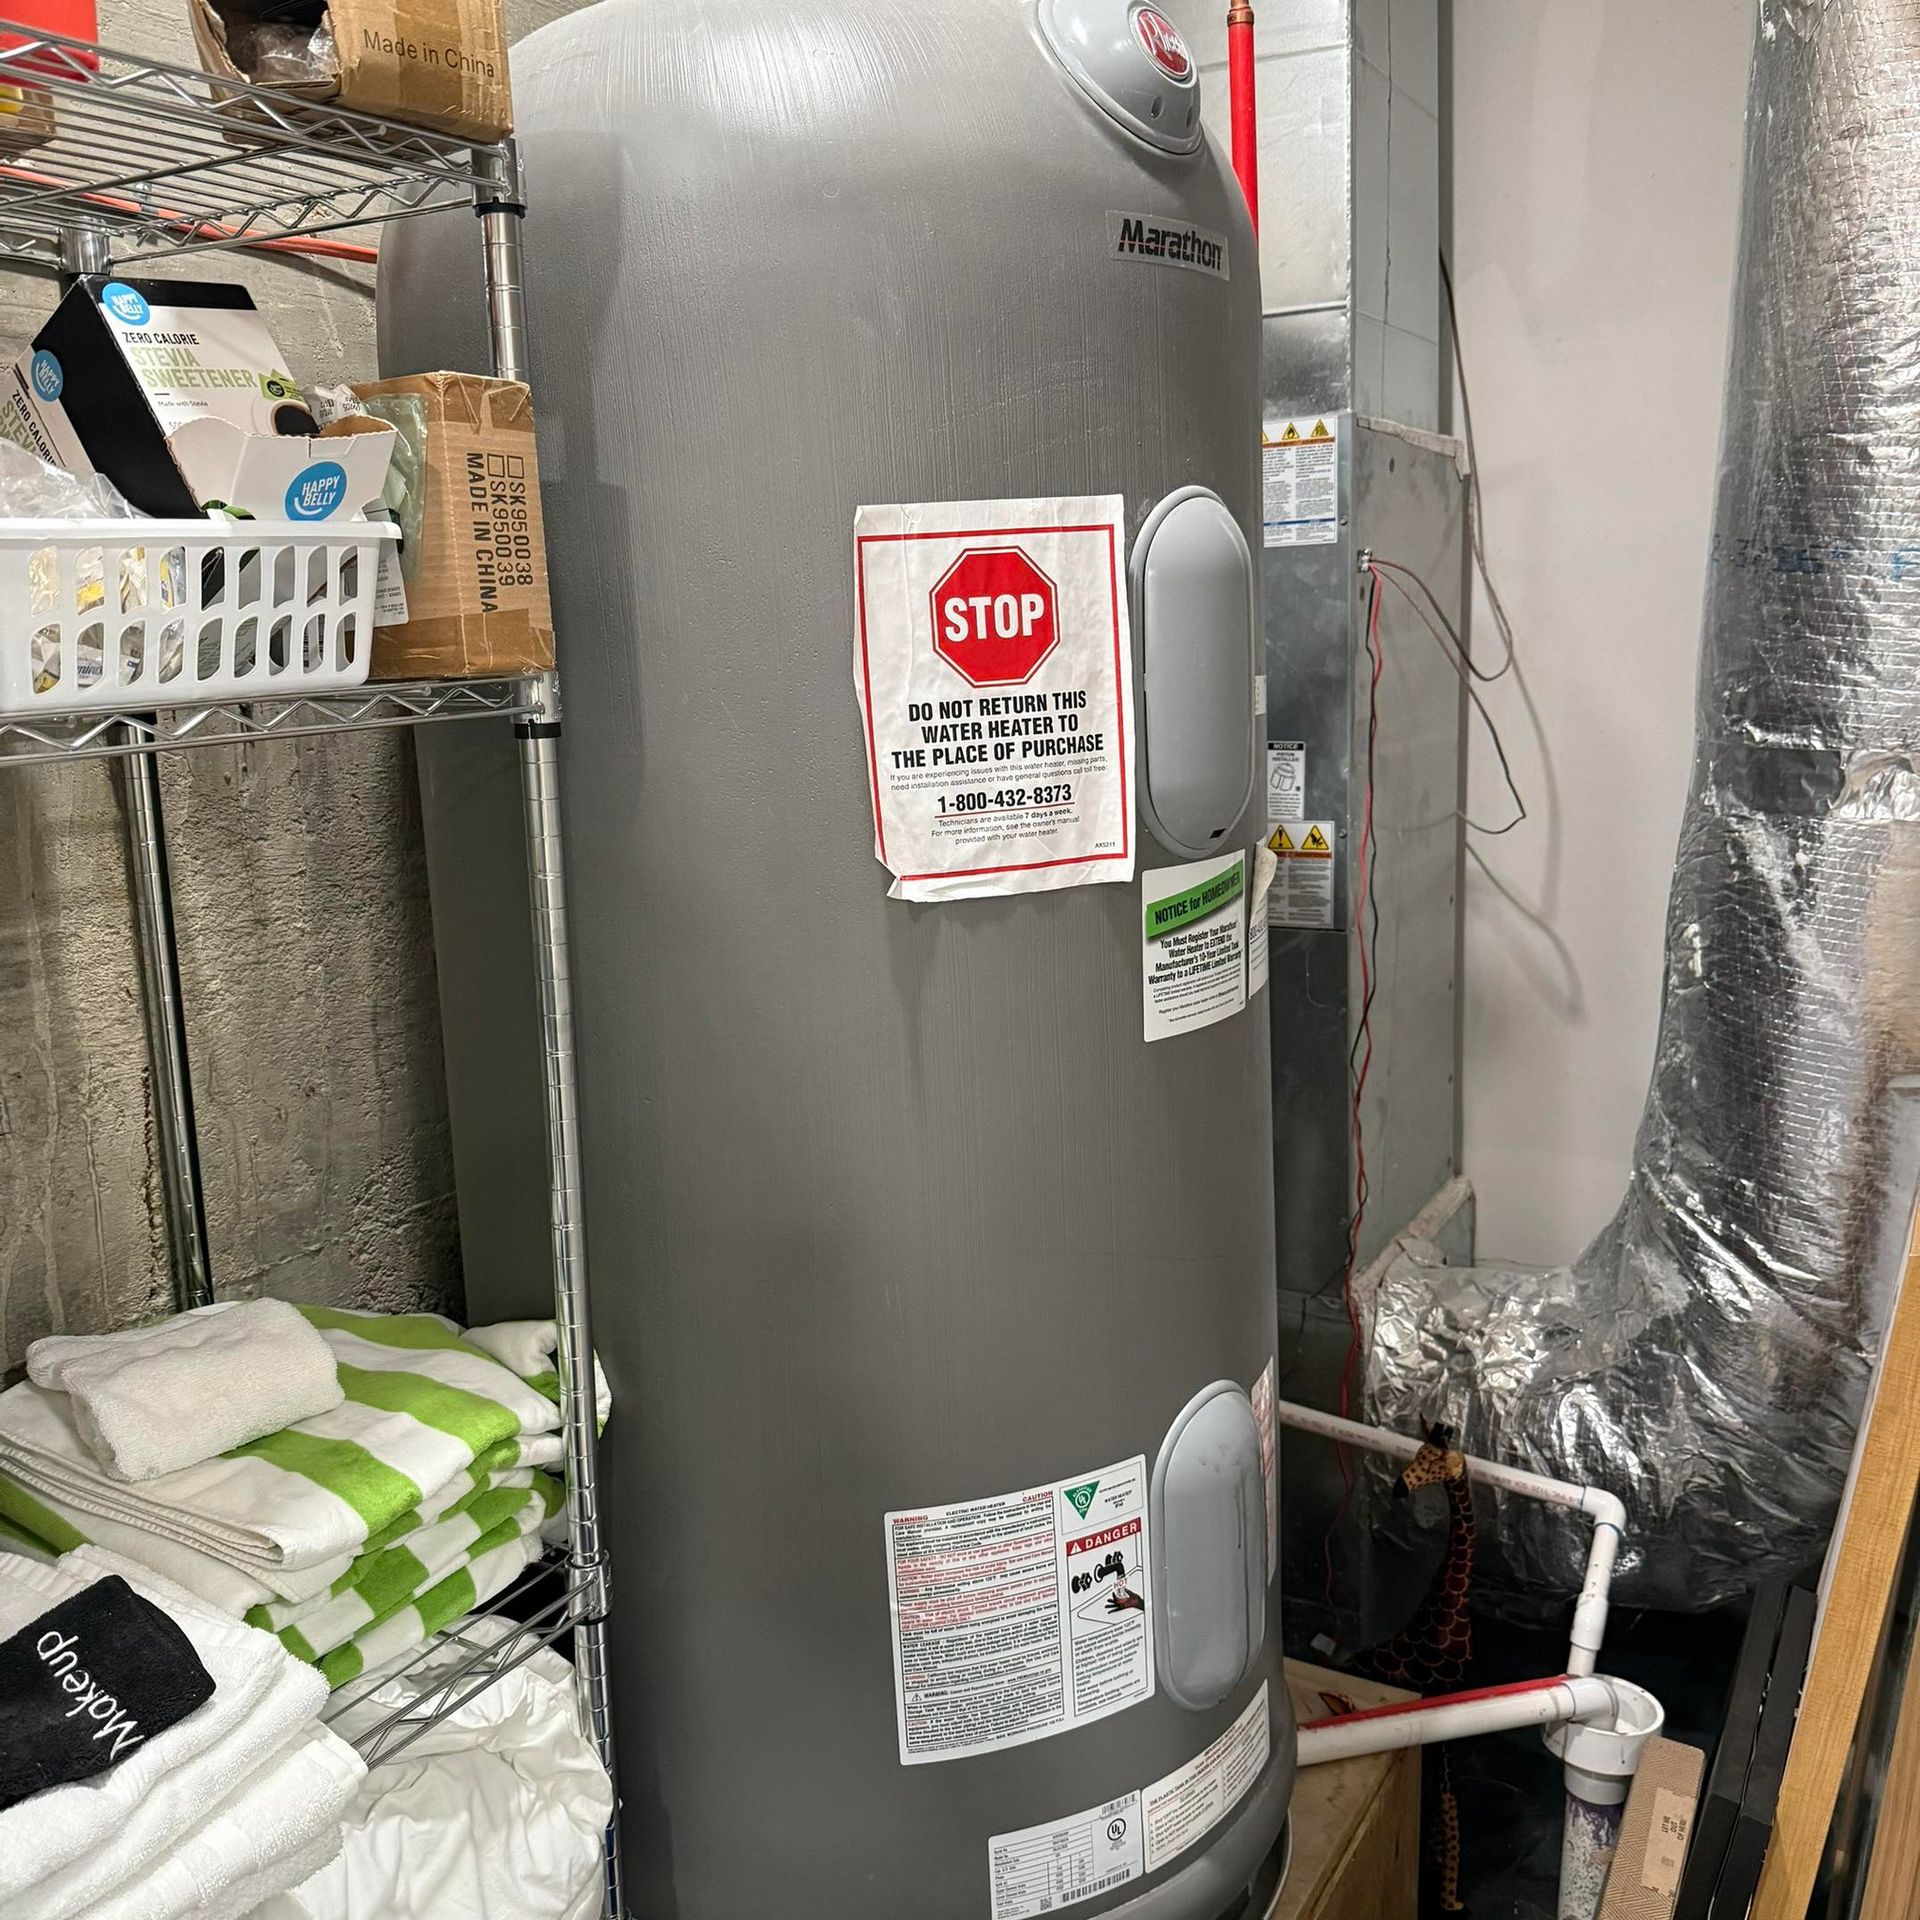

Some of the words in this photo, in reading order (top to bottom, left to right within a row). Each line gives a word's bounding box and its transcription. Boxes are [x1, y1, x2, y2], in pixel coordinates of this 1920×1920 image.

[363, 29, 418, 59] Made
[423, 42, 439, 65] in
[445, 48, 494, 78] China
[1118, 217, 1222, 271] Marathon
[110, 292, 137, 305] HAPPY
[120, 303, 144, 316] BELLY
[122, 332, 152, 344] ZERO
[153, 333, 200, 345] CALORIE
[130, 347, 200, 367] STEVIA
[38, 365, 55, 395] BELLY
[40, 358, 61, 387] HAPPY
[142, 369, 258, 389] SWEETENER
[12, 389, 32, 421] ZERO
[301, 475, 341, 496] HAPPY
[466, 452, 489, 513] MADE
[302, 491, 337, 507] BELLY
[472, 521, 492, 542] IN
[475, 549, 499, 613] CHINA
[944, 593, 1045, 642] STOP
[908, 702, 933, 722] DO
[939, 699, 973, 720] NOT
[979, 694, 1047, 717] RETURN
[1052, 690, 1087, 711] THIS
[921, 722, 983, 744] WATER
[988, 716, 1053, 738] HEATER
[1058, 713, 1079, 732] TO
[891, 749, 926, 769] THE
[932, 744, 988, 766] PLACE
[993, 742, 1015, 761] OF
[1022, 733, 1104, 759] PURCHASE
[891, 783, 909, 791] need
[911, 780, 949, 790] installation
[951, 777, 986, 787] assistance
[1015, 772, 1041, 782] general
[1042, 769, 1074, 779] questions
[1073, 767, 1084, 775] call
[925, 769, 970, 780] experiencing
[970, 766, 993, 775] issues
[1010, 763, 1023, 771] this
[1023, 762, 1043, 770] water
[1067, 758, 1089, 766] missing
[937, 783, 1072, 813] 1-800-432-8373
[931, 830, 943, 838] For
[964, 824, 1004, 835] information,
[1032, 820, 1056, 828] owner's
[1056, 816, 1080, 825] manual
[939, 817, 978, 828] Technicians
[993, 813, 1024, 823] available
[1031, 810, 1048, 819] days
[1054, 807, 1073, 816] week.
[955, 836, 985, 845] provided
[987, 833, 1001, 841] with
[1002, 833, 1017, 841] your
[1155, 901, 1189, 925] NOTICE
[1189, 897, 1201, 912] for
[1160, 938, 1172, 949] You
[1172, 935, 1187, 947] Must
[1188, 930, 1209, 943] Register
[1209, 927, 1219, 938] Your
[1168, 947, 1186, 958] Water
[1187, 943, 1204, 954] Heater
[1204, 942, 1209, 950] to
[1210, 934, 1226, 948] EXTEND
[1148, 971, 1176, 985] Warranty
[1177, 970, 1183, 979] to
[1183, 969, 1188, 977] a
[1188, 961, 1211, 976] LIFETIME
[1211, 956, 1226, 969] Limited
[1155, 954, 1199, 973] Manufacturer's
[1199, 950, 1217, 962] 10-Year
[893, 1514, 928, 1524] WARNING
[946, 1508, 969, 1516] ELECTRIC
[1023, 1490, 1053, 1502] CAUTION
[1085, 1522, 1137, 1549] DANGER
[1113, 1578, 1128, 1589] HOT
[37, 1631, 145, 1760] Makeup
